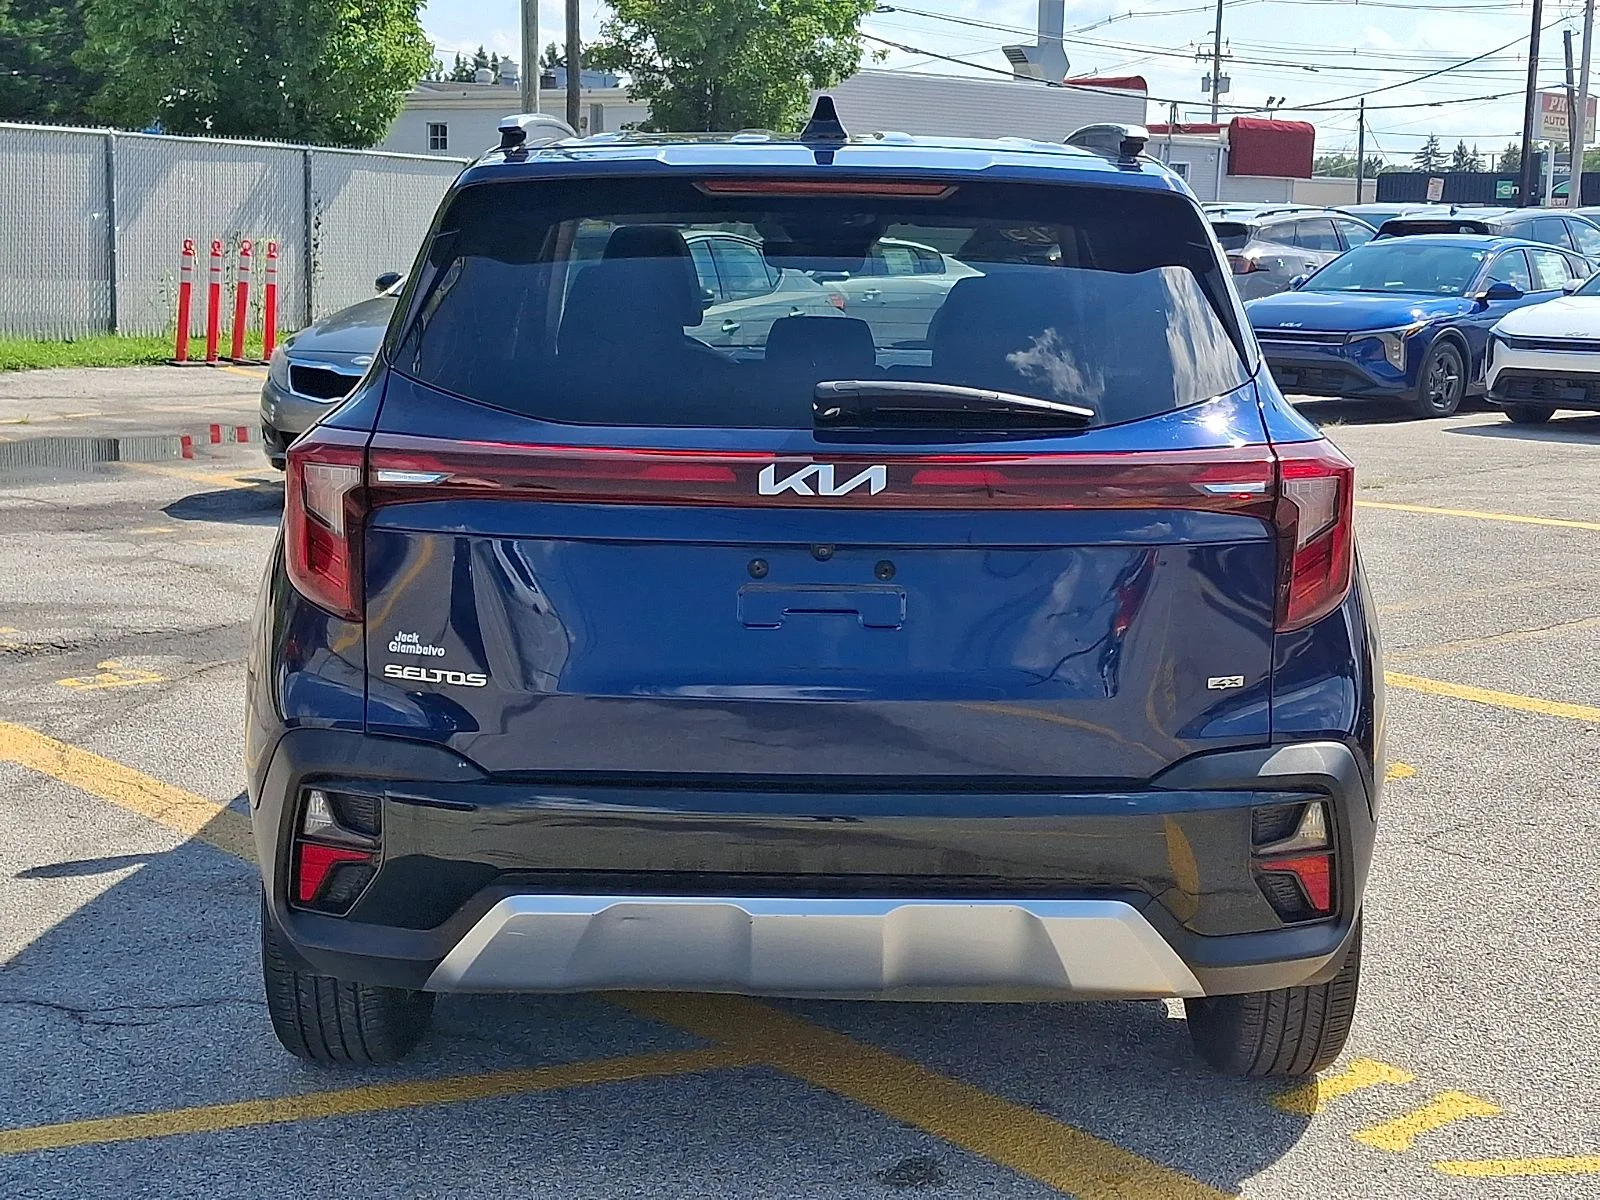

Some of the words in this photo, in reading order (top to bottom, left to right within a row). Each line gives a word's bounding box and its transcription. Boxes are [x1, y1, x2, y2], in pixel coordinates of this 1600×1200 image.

[1544, 115, 1566, 126] AUTO
[759, 464, 887, 496] KIA
[394, 630, 420, 643] Jack
[384, 664, 487, 687] SELTOS
